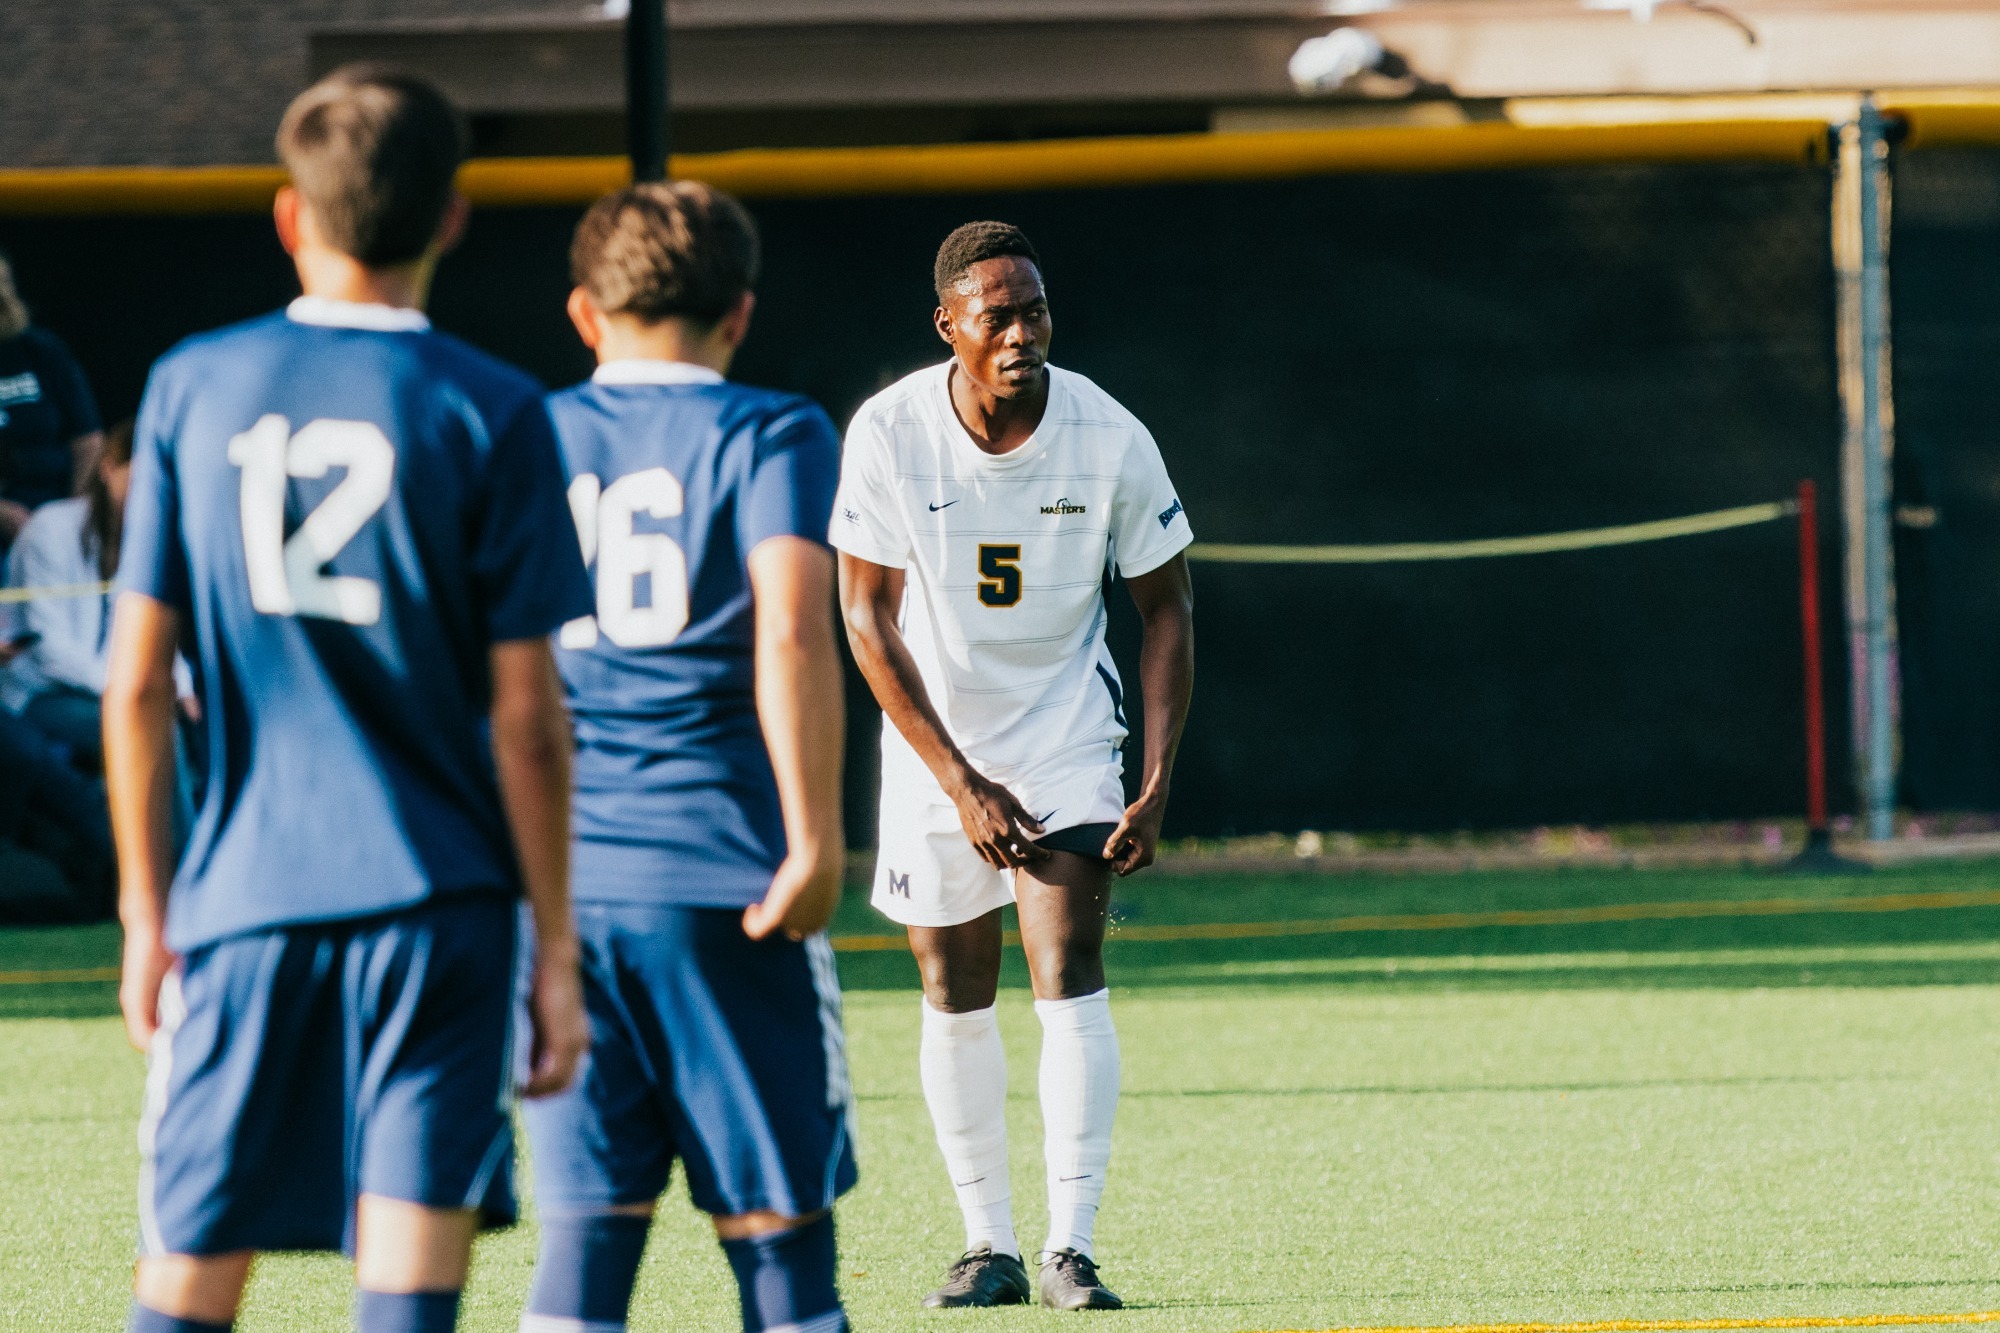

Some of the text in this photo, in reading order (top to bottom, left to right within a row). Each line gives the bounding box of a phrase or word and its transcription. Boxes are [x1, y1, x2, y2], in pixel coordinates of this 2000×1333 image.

[227, 413, 395, 626] 12
[977, 543, 1022, 607] 5
[888, 868, 911, 900] M
